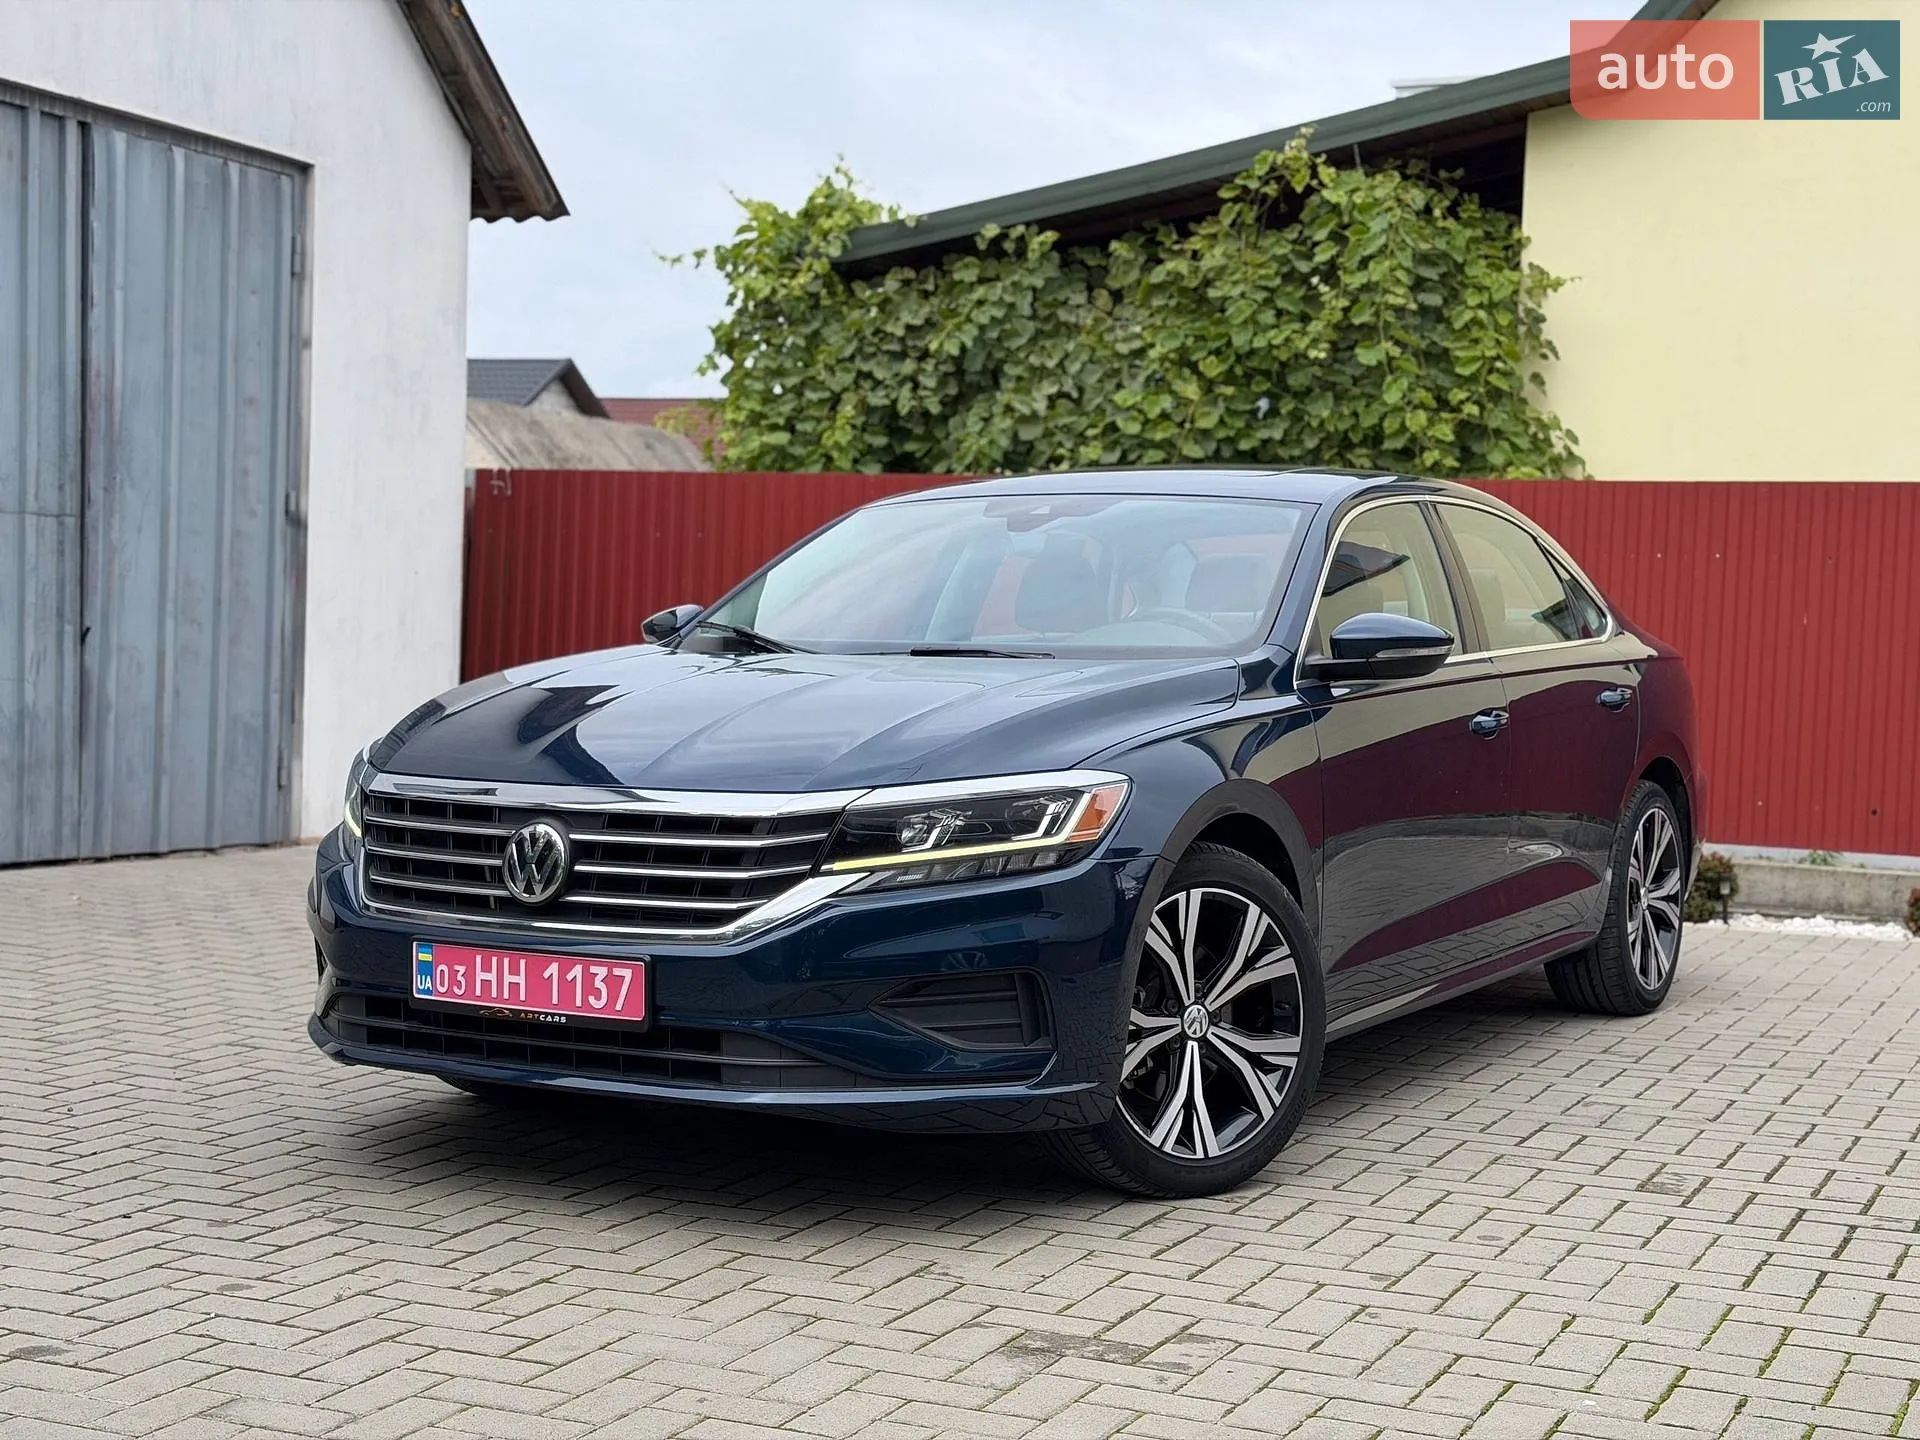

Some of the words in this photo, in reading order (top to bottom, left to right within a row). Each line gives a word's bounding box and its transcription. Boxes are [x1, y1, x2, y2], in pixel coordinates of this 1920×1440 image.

[503, 823, 564, 903] VW
[417, 974, 433, 991] UA
[436, 964, 467, 996] 03
[475, 954, 527, 1001] HH
[542, 961, 633, 1012] 1137
